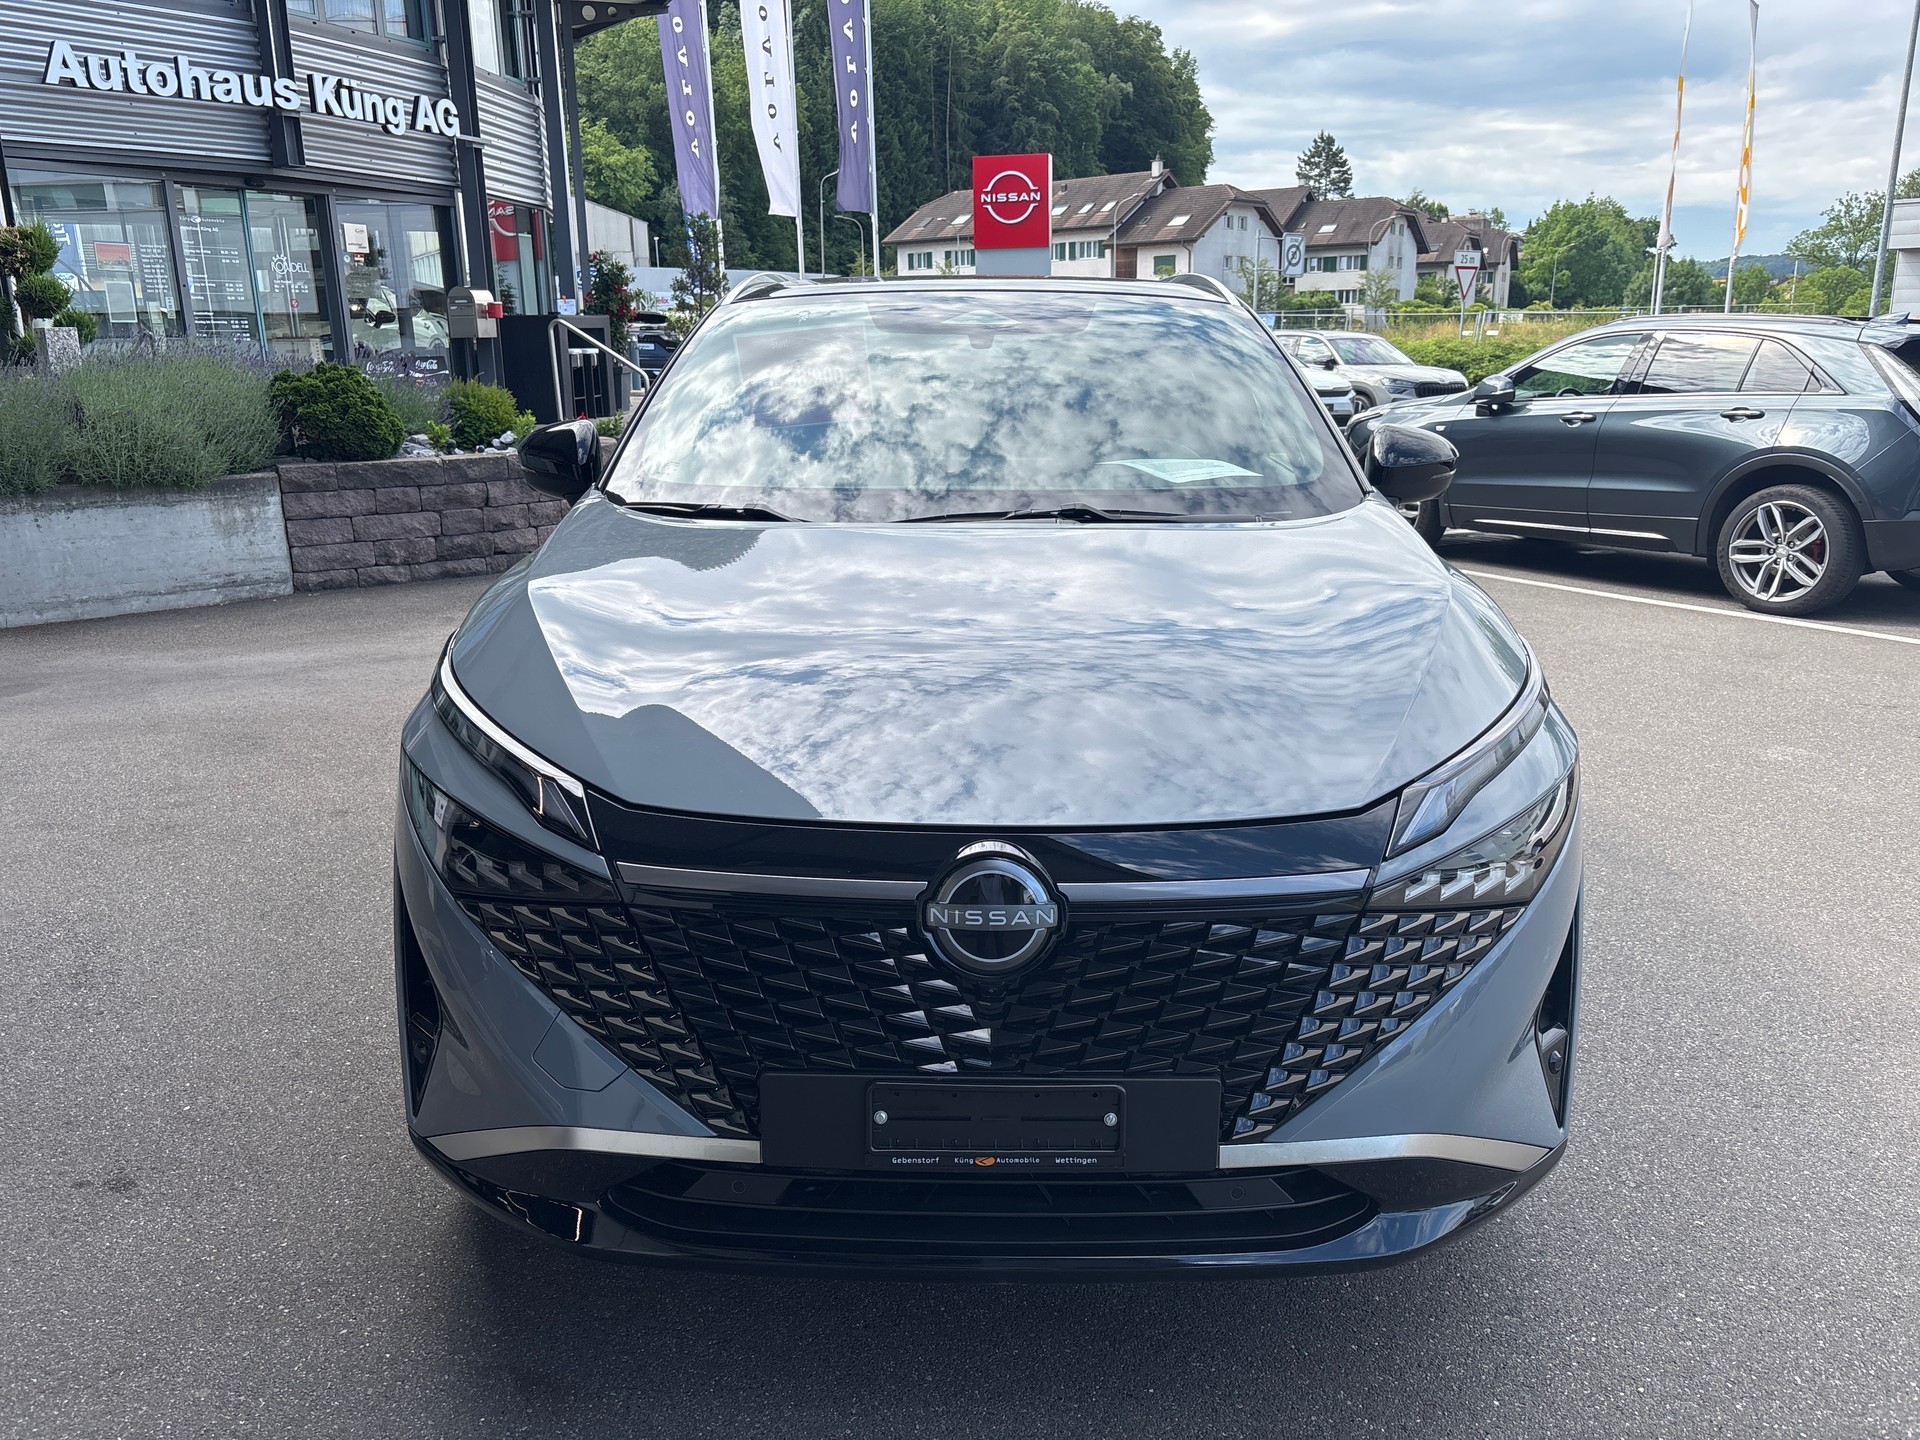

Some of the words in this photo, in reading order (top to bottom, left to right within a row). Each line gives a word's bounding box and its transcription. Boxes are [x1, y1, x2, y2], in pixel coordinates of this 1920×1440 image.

[44, 41, 302, 110] Autohaus
[308, 72, 406, 136] Küng
[410, 95, 462, 138] AG
[981, 192, 1041, 203] NISSAN
[1460, 254, 1468, 264] 25
[930, 907, 1055, 925] NISSAN
[892, 1156, 940, 1164] Gebenstorf
[954, 1157, 974, 1165] Küng
[1055, 1156, 1098, 1165] Wettingen
